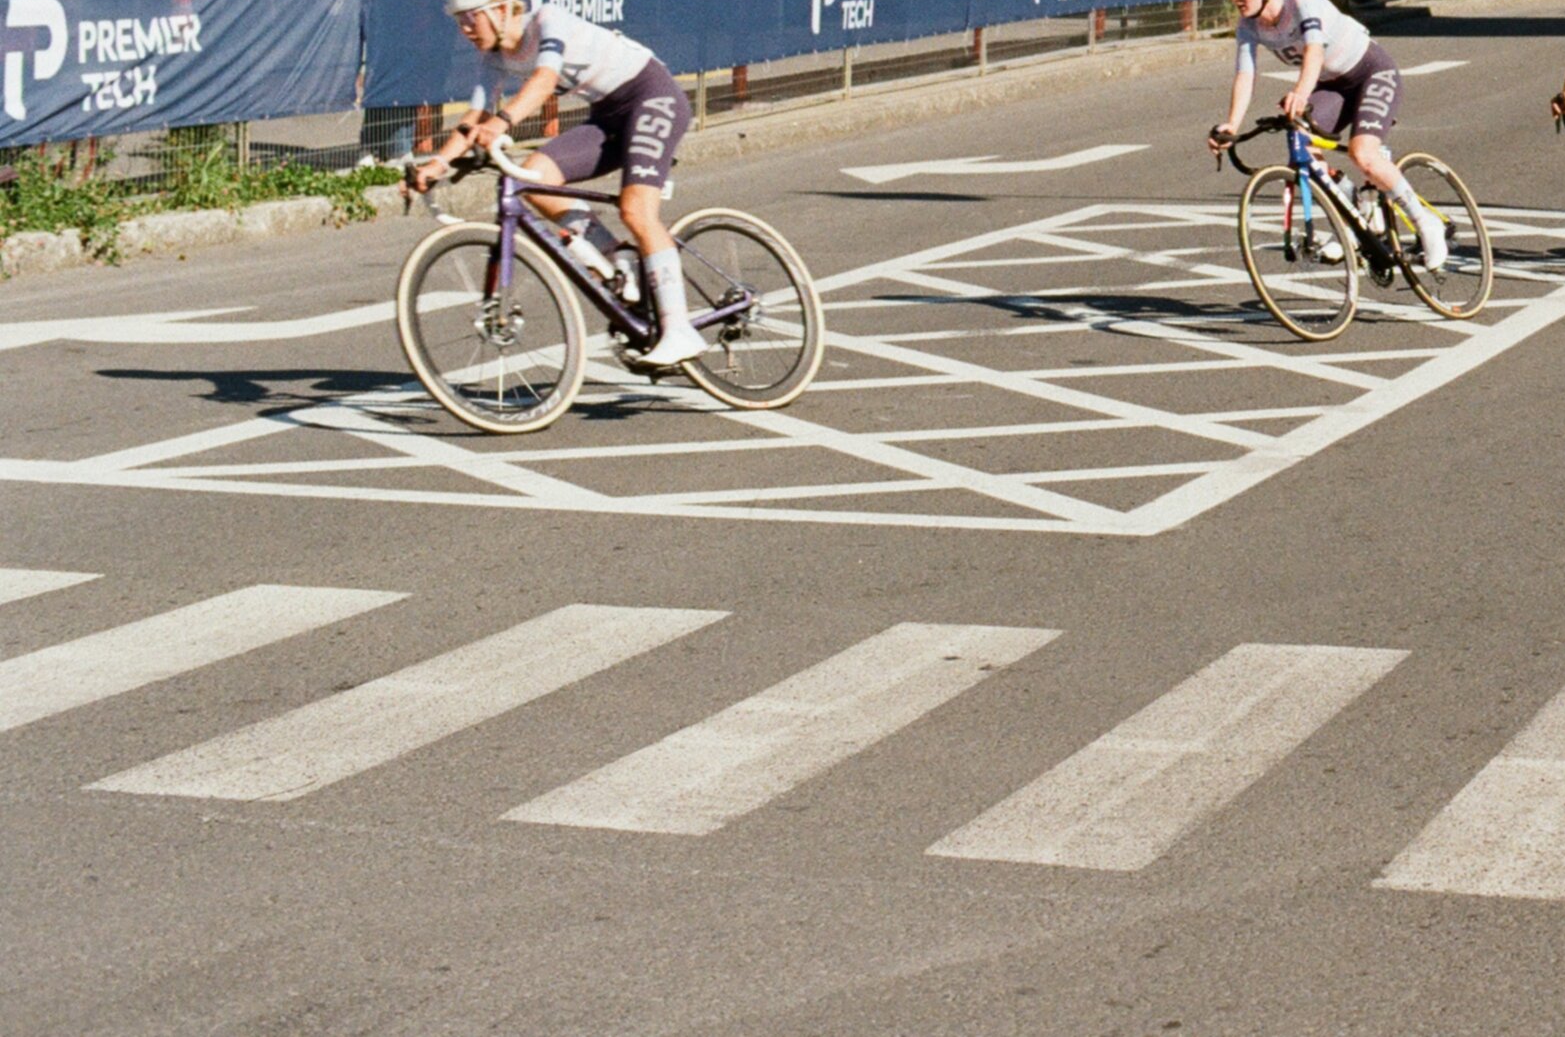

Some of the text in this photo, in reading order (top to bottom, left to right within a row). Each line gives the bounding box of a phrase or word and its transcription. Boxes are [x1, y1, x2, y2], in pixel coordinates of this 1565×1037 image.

[78, 14, 202, 64] PREMIER
[80, 64, 158, 112] TECH
[1358, 68, 1397, 117] USA
[628, 96, 677, 160] USA
